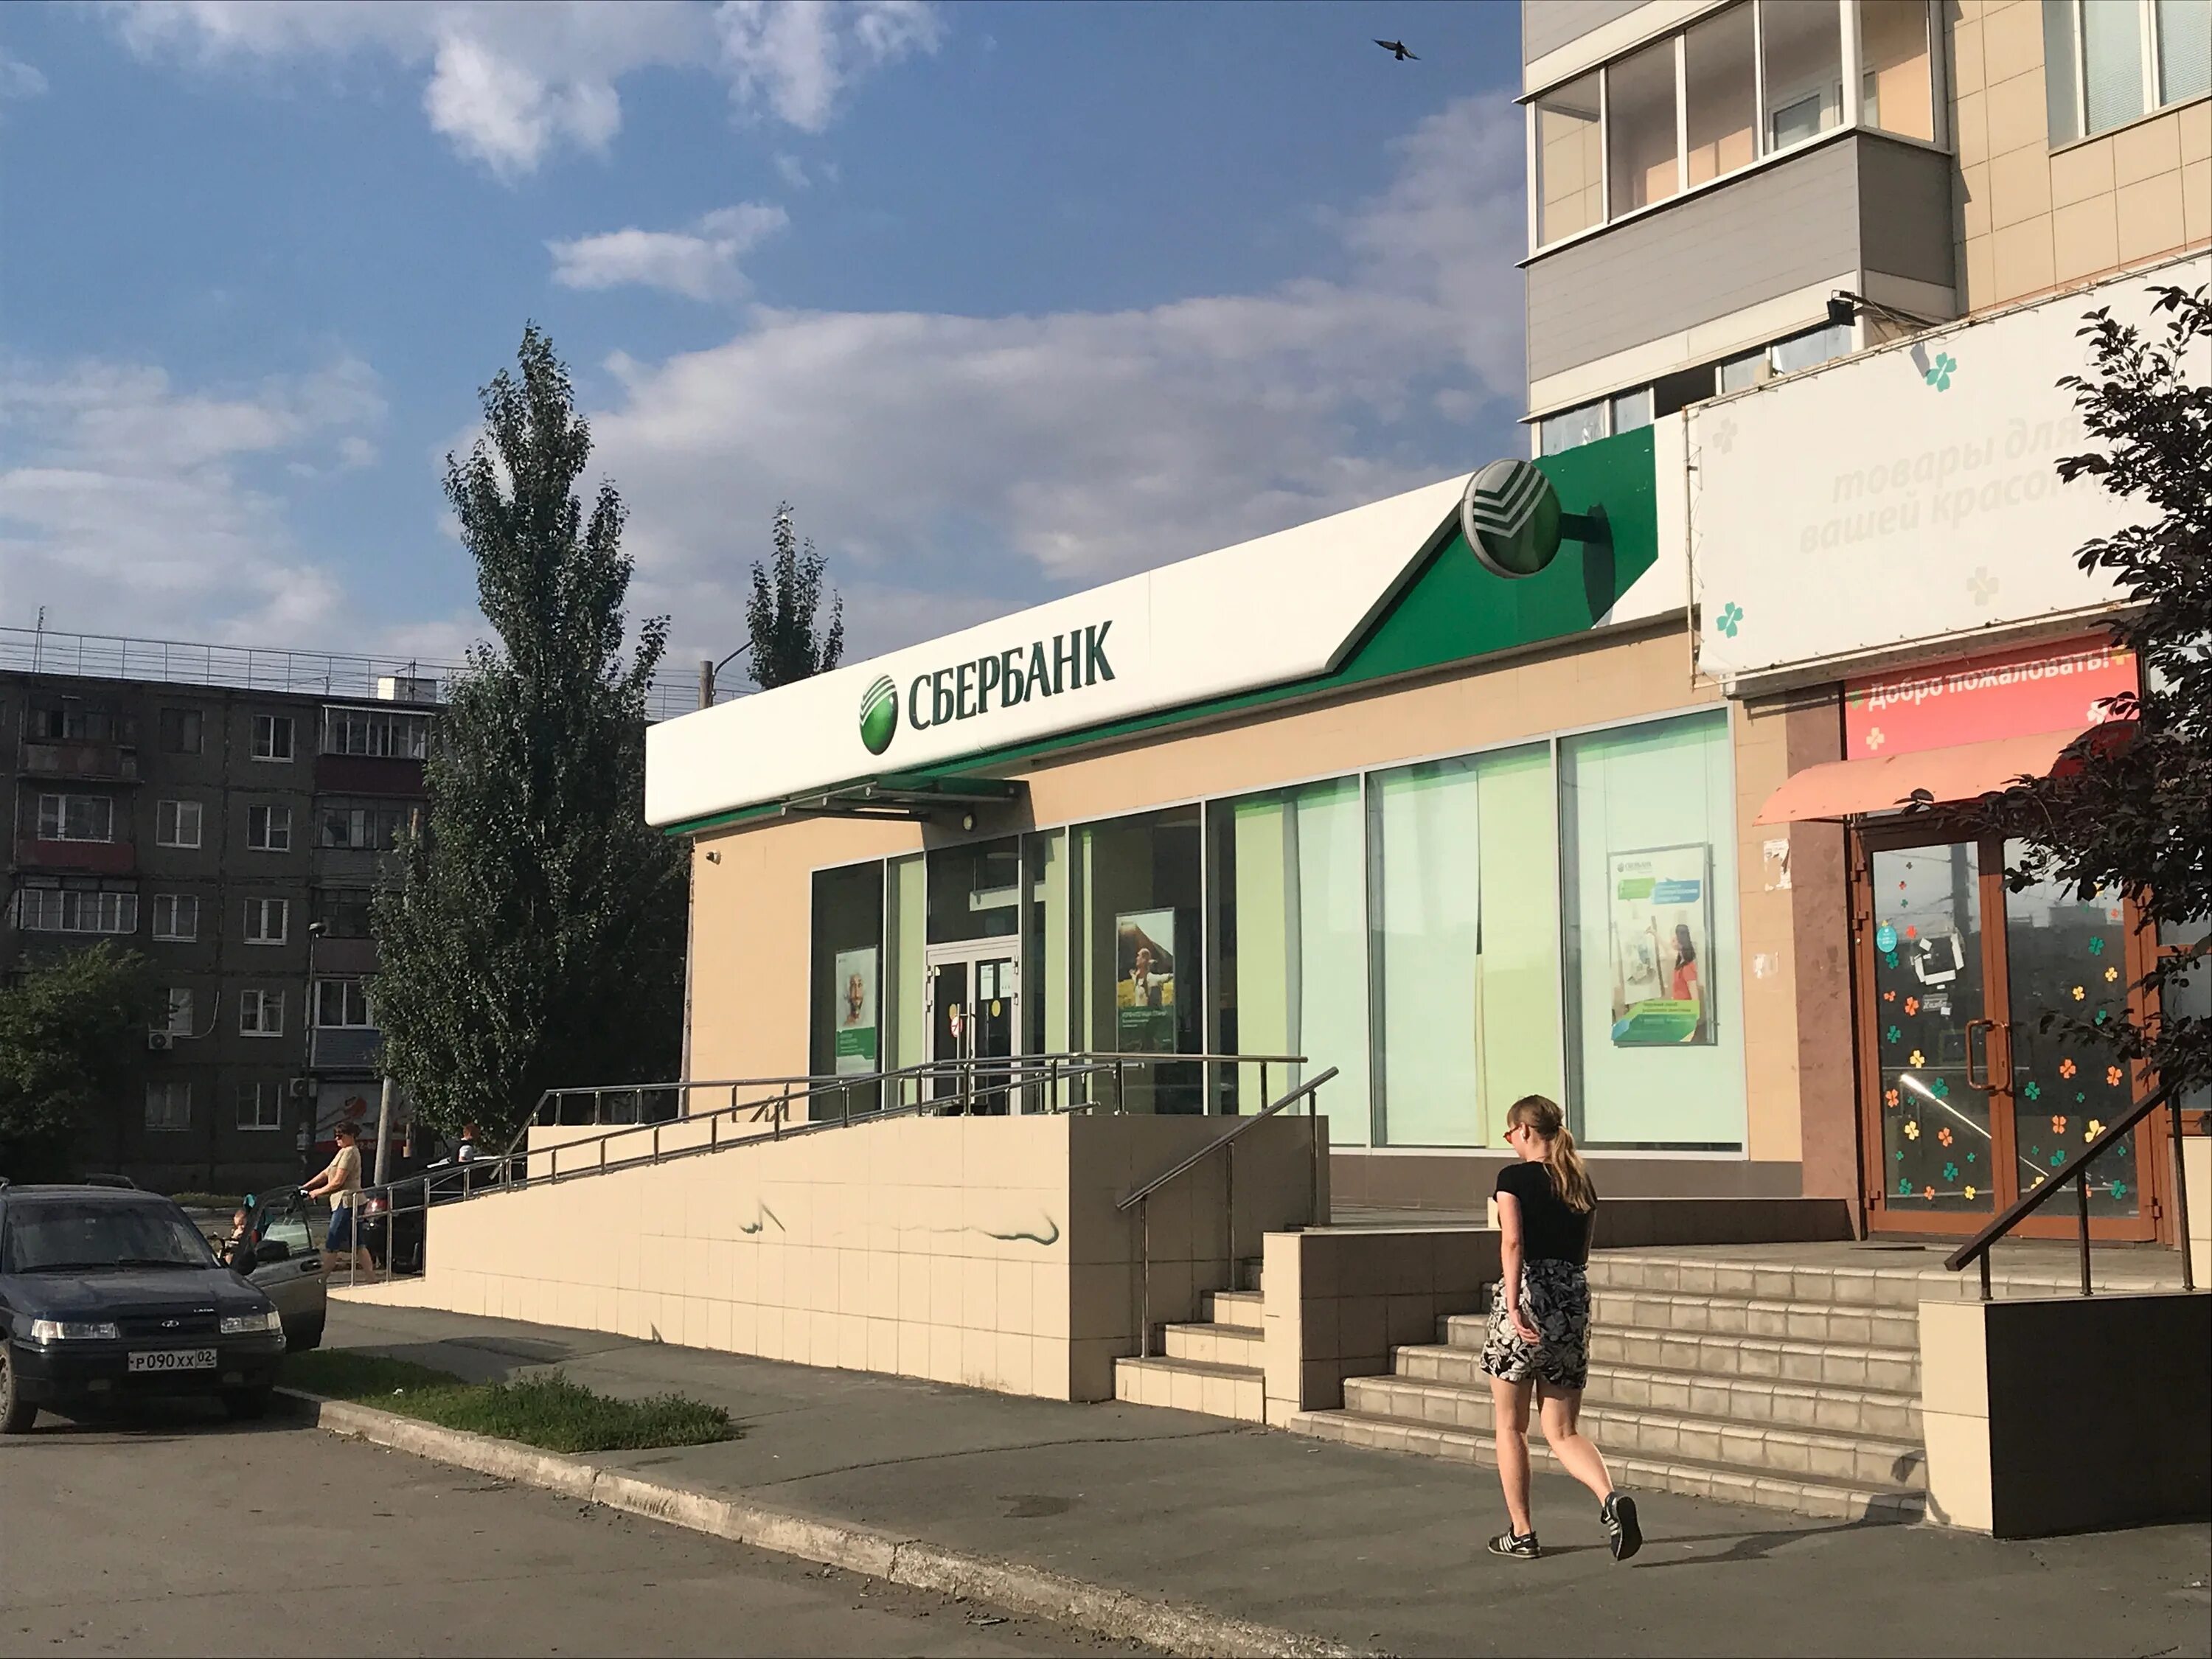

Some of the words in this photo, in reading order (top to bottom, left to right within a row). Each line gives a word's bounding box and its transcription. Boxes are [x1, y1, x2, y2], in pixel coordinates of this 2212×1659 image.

[1832, 437, 1994, 504] товары
[2005, 414, 2081, 460] для
[1799, 489, 1921, 554] вашей
[908, 620, 1116, 730] СБЕРБАНК
[1868, 676, 1944, 712] Добро
[1948, 644, 2110, 693] пожаловать!
